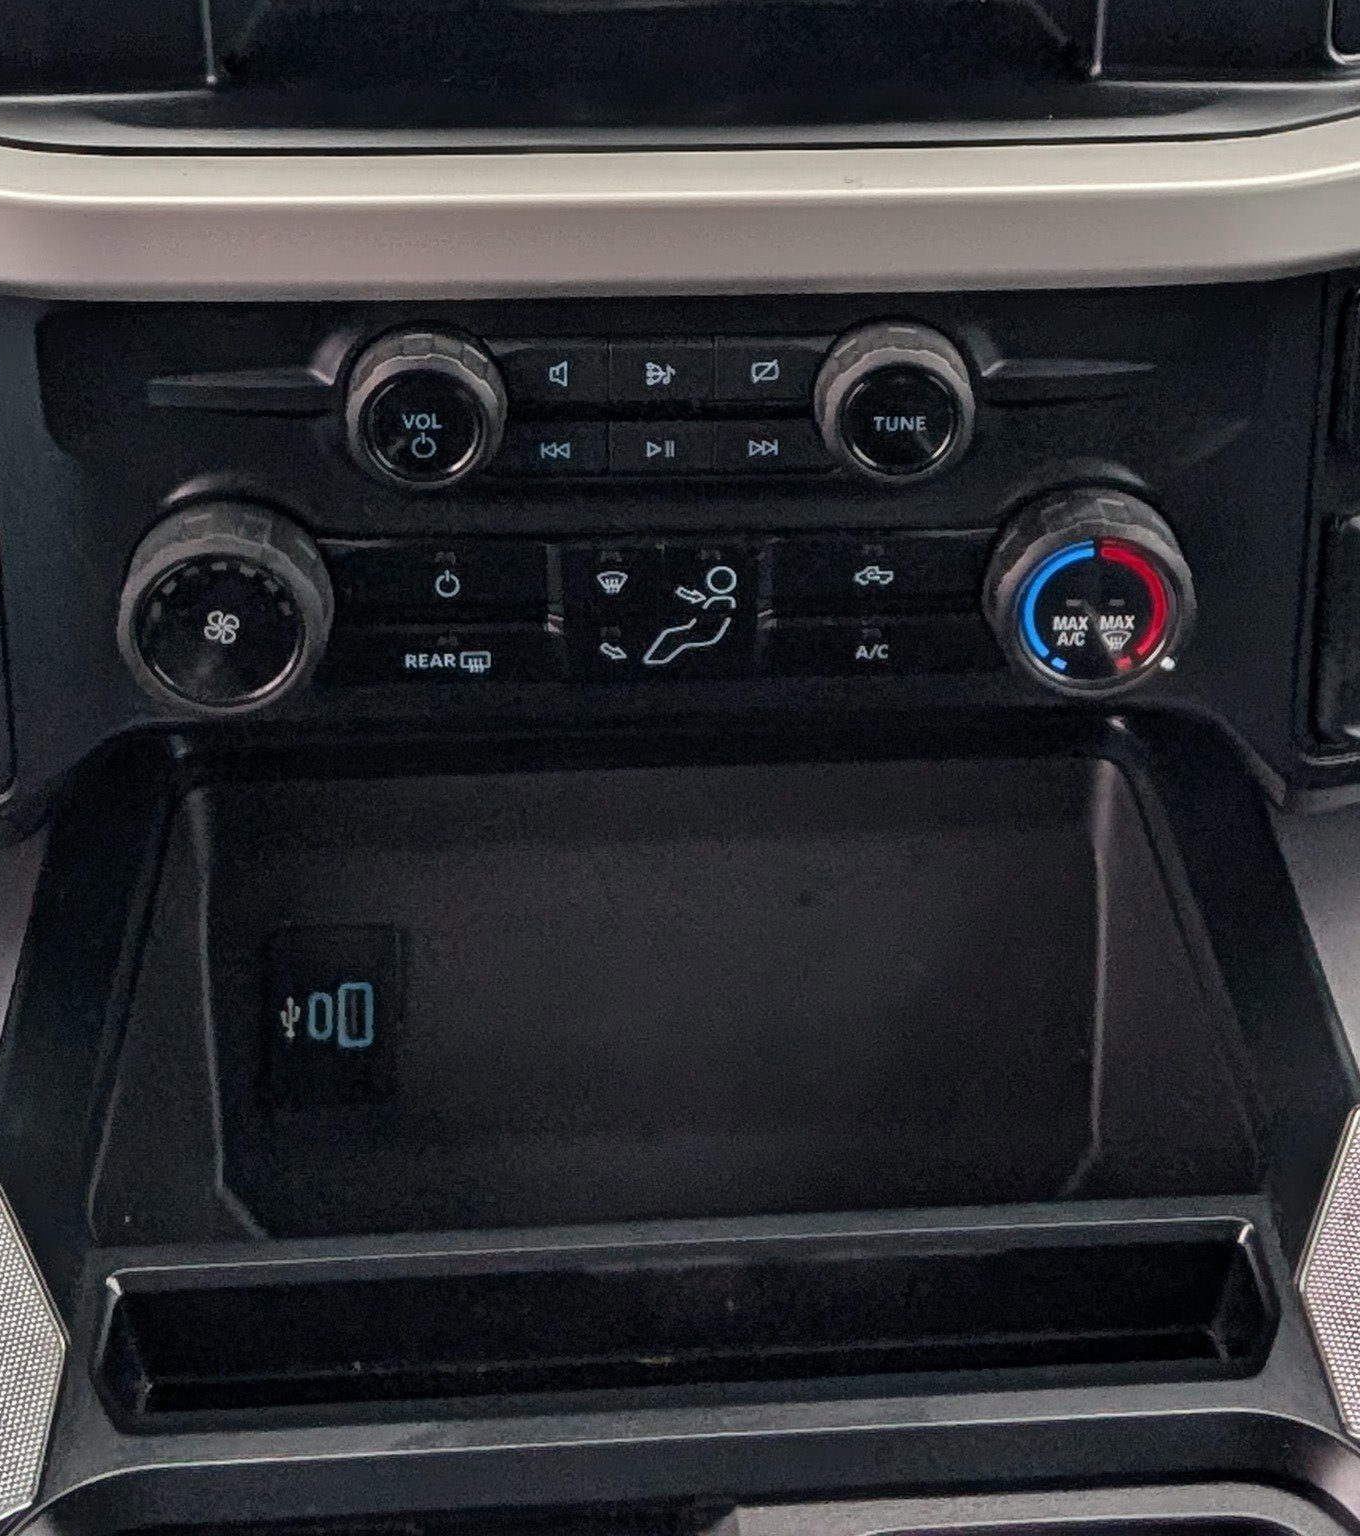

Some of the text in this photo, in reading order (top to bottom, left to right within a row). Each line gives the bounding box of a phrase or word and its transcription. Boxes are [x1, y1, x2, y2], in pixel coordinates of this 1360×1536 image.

[402, 413, 442, 430] VOL
[873, 415, 927, 431] TUNE
[1052, 615, 1088, 632] MAX
[1099, 614, 1135, 631] MAX
[1056, 630, 1086, 646] A/C
[855, 643, 890, 660] A/C
[404, 653, 456, 669] REAR
